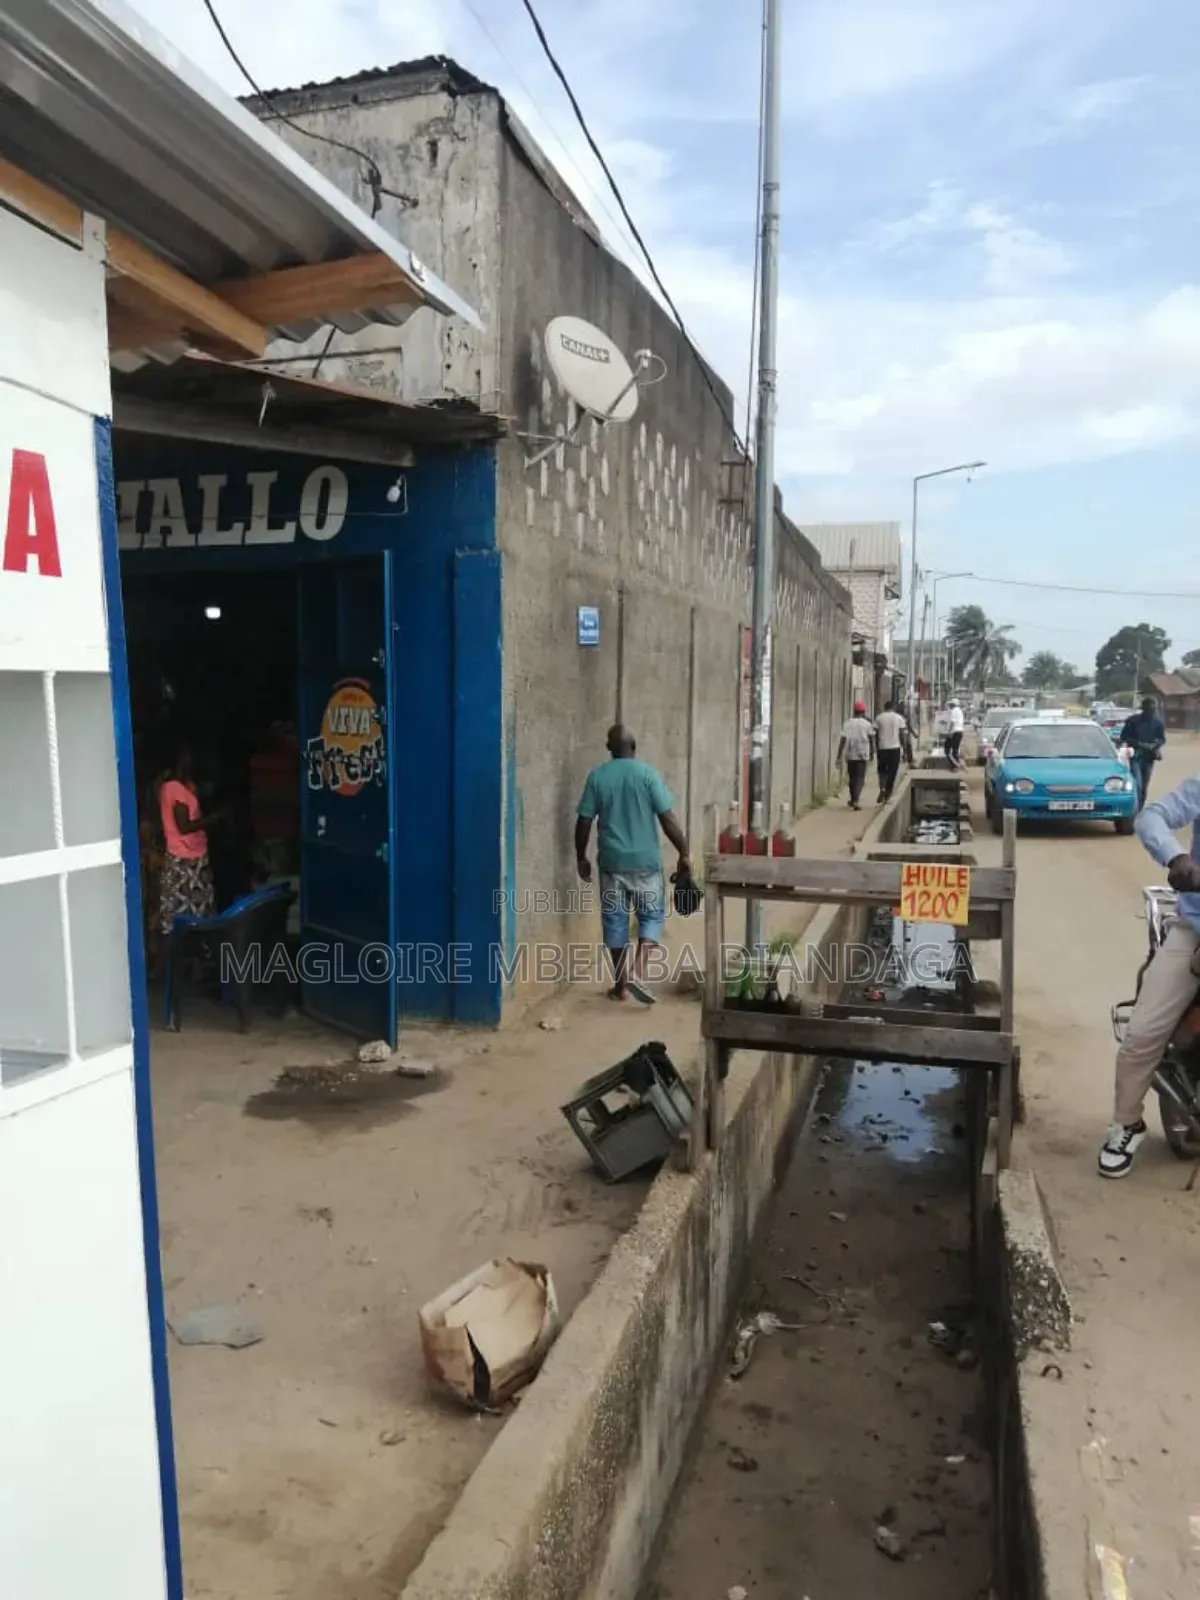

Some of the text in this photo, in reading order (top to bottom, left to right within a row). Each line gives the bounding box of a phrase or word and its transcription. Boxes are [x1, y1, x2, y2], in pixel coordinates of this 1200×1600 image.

[562, 336, 609, 361] CANAL+
[3, 448, 62, 577] A
[327, 706, 371, 735] VIVA
[903, 865, 967, 888] HUILE
